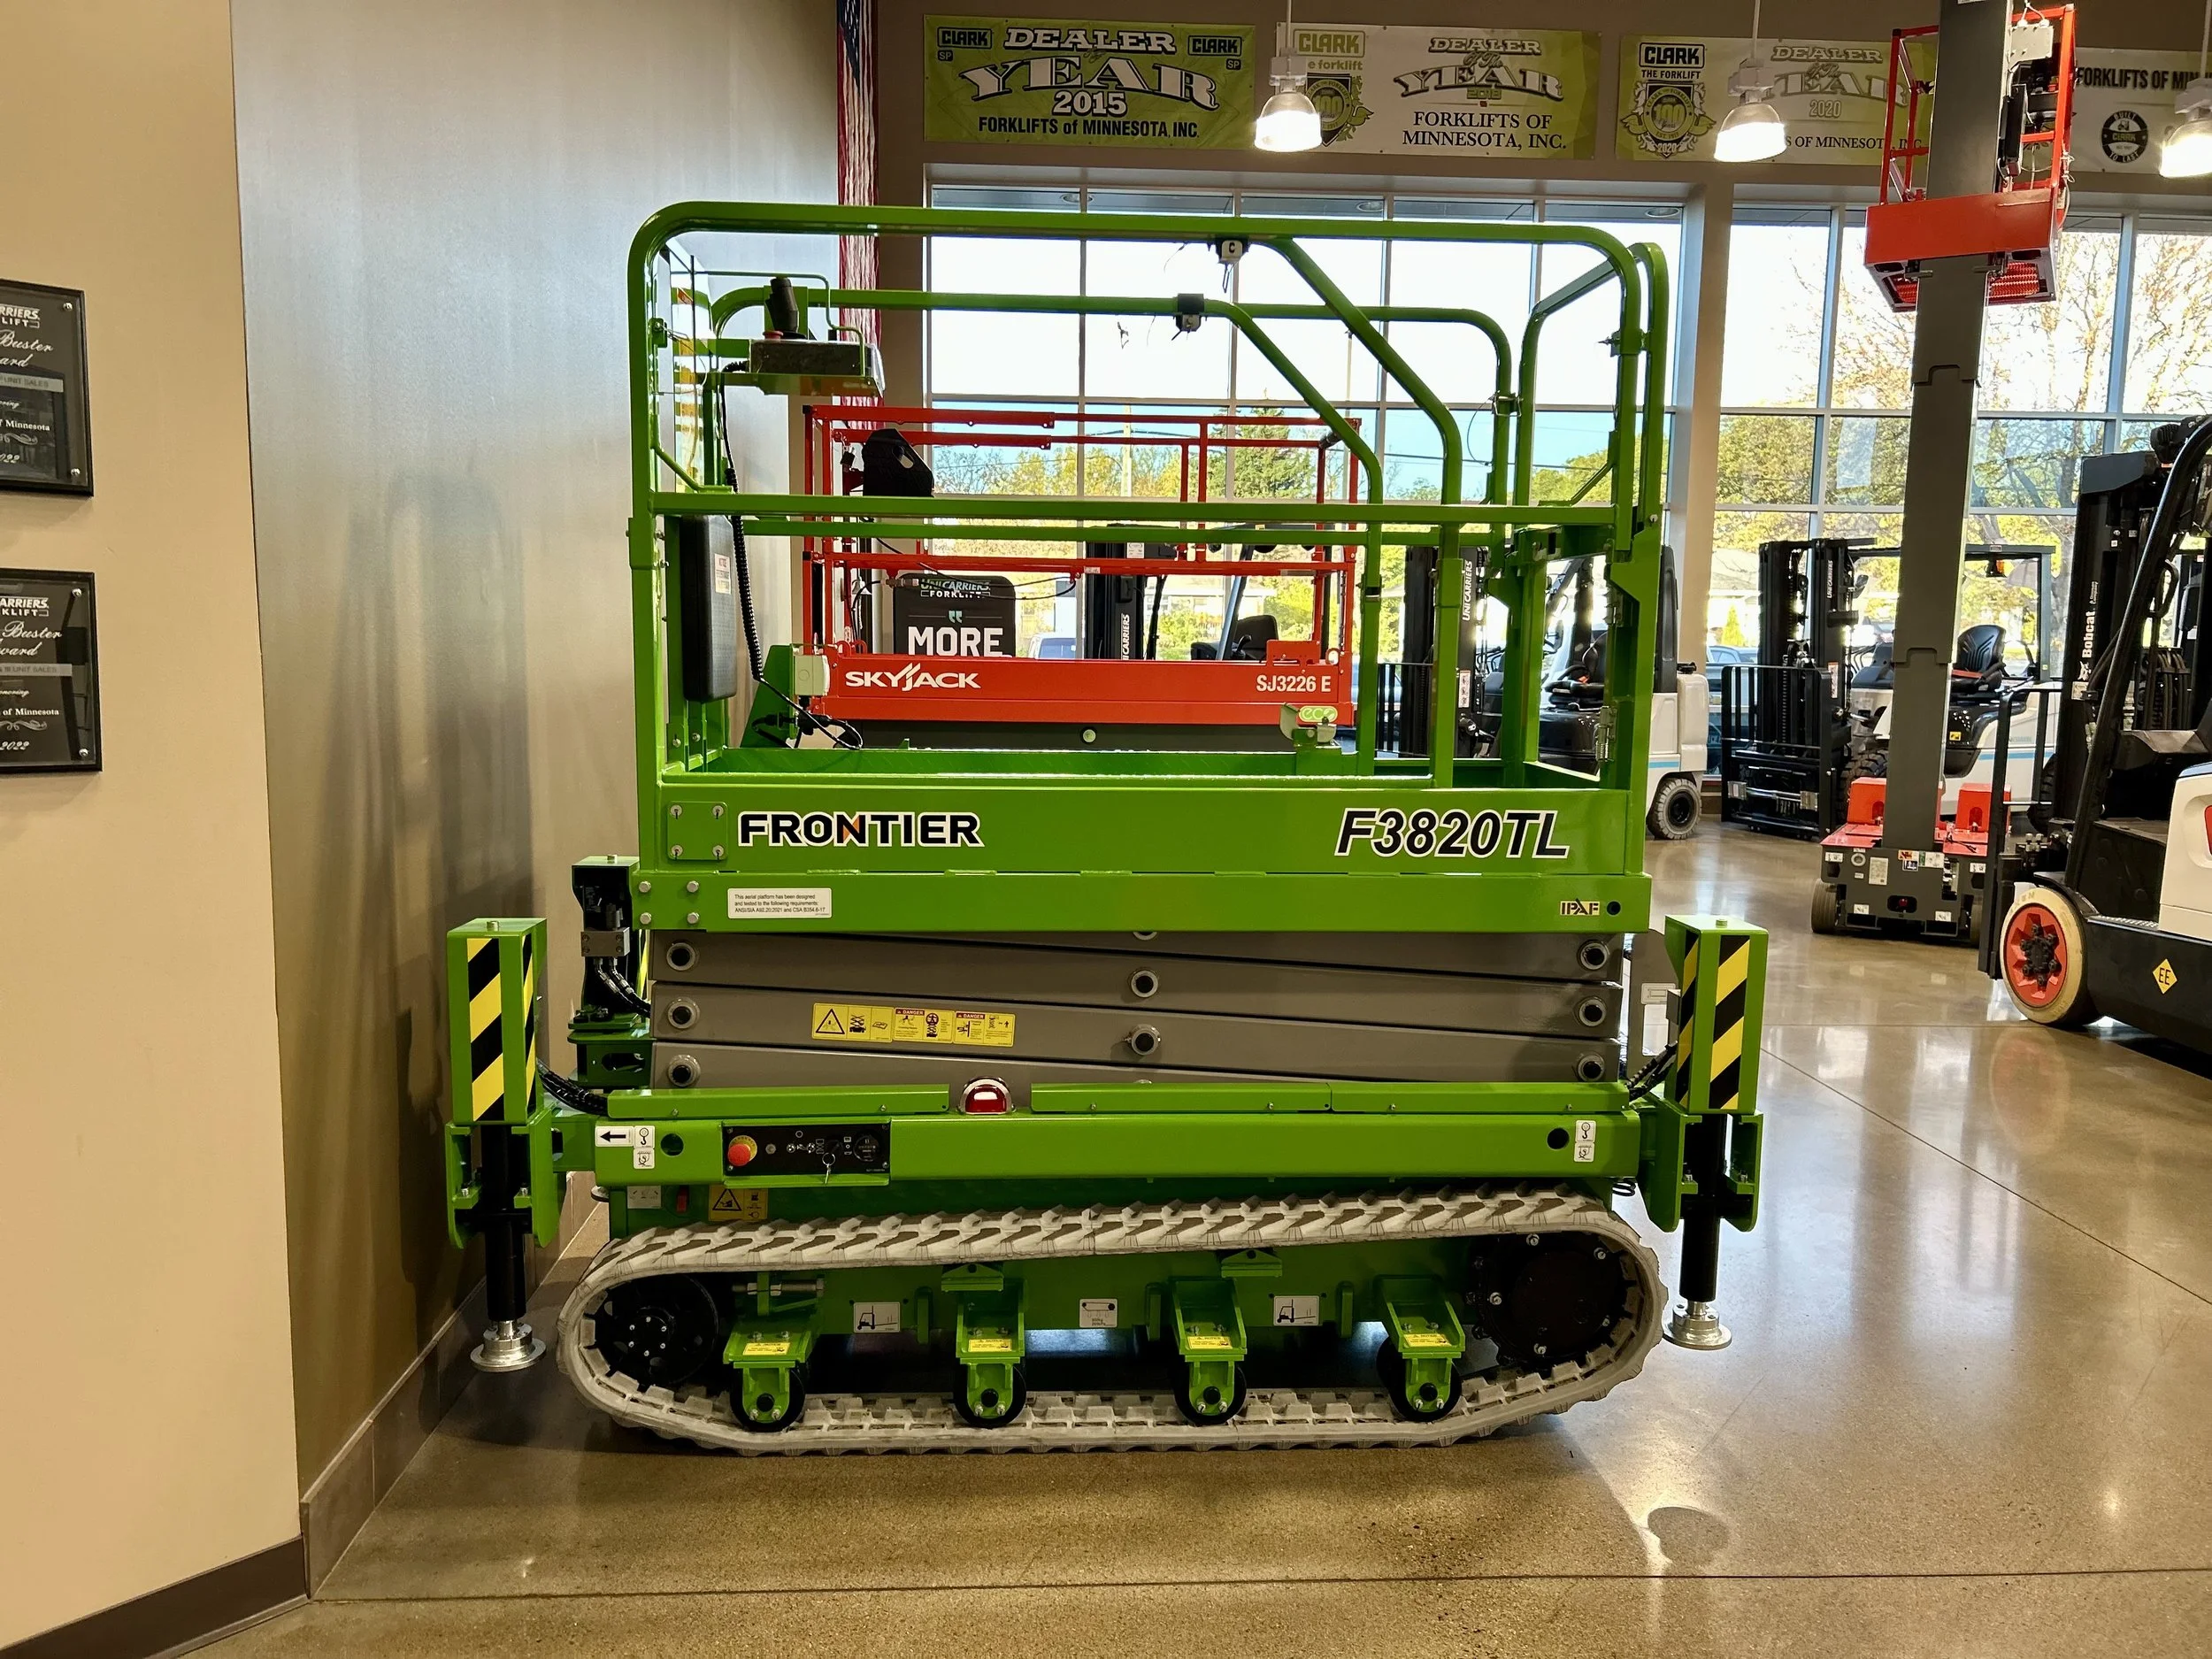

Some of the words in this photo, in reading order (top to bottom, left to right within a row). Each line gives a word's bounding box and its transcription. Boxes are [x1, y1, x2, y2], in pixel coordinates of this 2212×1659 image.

[941, 30, 989, 46] CLARK
[1004, 27, 1177, 55] DEALER
[1192, 38, 1238, 54] CLARK
[1298, 33, 1360, 54] CLARK
[1428, 37, 1542, 56] DEALER
[938, 50, 953, 61] SP
[1226, 59, 1240, 70] SP
[1645, 46, 1699, 65] CLARK
[1770, 46, 1884, 64] DEALER
[1318, 59, 1363, 71] forklift
[958, 56, 1220, 111] YEAR
[1394, 64, 1564, 102] YEAR
[1641, 70, 1657, 79] THE
[1660, 70, 1701, 80] FORKLIFT
[2076, 67, 2148, 88] FORKLIFTS
[2151, 70, 2169, 89] OF
[1051, 90, 1127, 117] 2015
[1809, 100, 1842, 119] 2020
[979, 117, 1058, 135] FORKLIFTS
[1063, 119, 1078, 135] of
[1082, 119, 1171, 138] MINNESOTA,
[1173, 121, 1200, 138] INC.
[1413, 111, 1519, 128] FORKLIFTS
[1525, 114, 1553, 129] OF
[1402, 130, 1522, 150] MINNESOTA,
[1528, 134, 1567, 150] INC.
[1657, 142, 1678, 154] 2020
[1794, 136, 1813, 149] OF
[1816, 137, 1895, 150] MINNESOT,
[2123, 150, 2139, 162] LAST
[1228, 242, 1235, 254] C
[5, 419, 50, 431] Minnesota
[1463, 559, 1473, 621] UNICARRIERS
[2, 608, 38, 617] KLIFT
[2, 620, 62, 639] Buster
[2082, 611, 2096, 658] Bobcat
[0, 638, 42, 656] ward
[908, 626, 1003, 657] MORE
[845, 663, 981, 692] SKYJACK
[1256, 675, 1317, 692] SJ3226
[1321, 676, 1331, 692] E
[0, 741, 30, 751] 2022
[739, 812, 984, 846] FRONTIER
[1334, 808, 1571, 859] F3820TL
[1561, 899, 1599, 916] IPAF
[2158, 967, 2172, 987] EE
